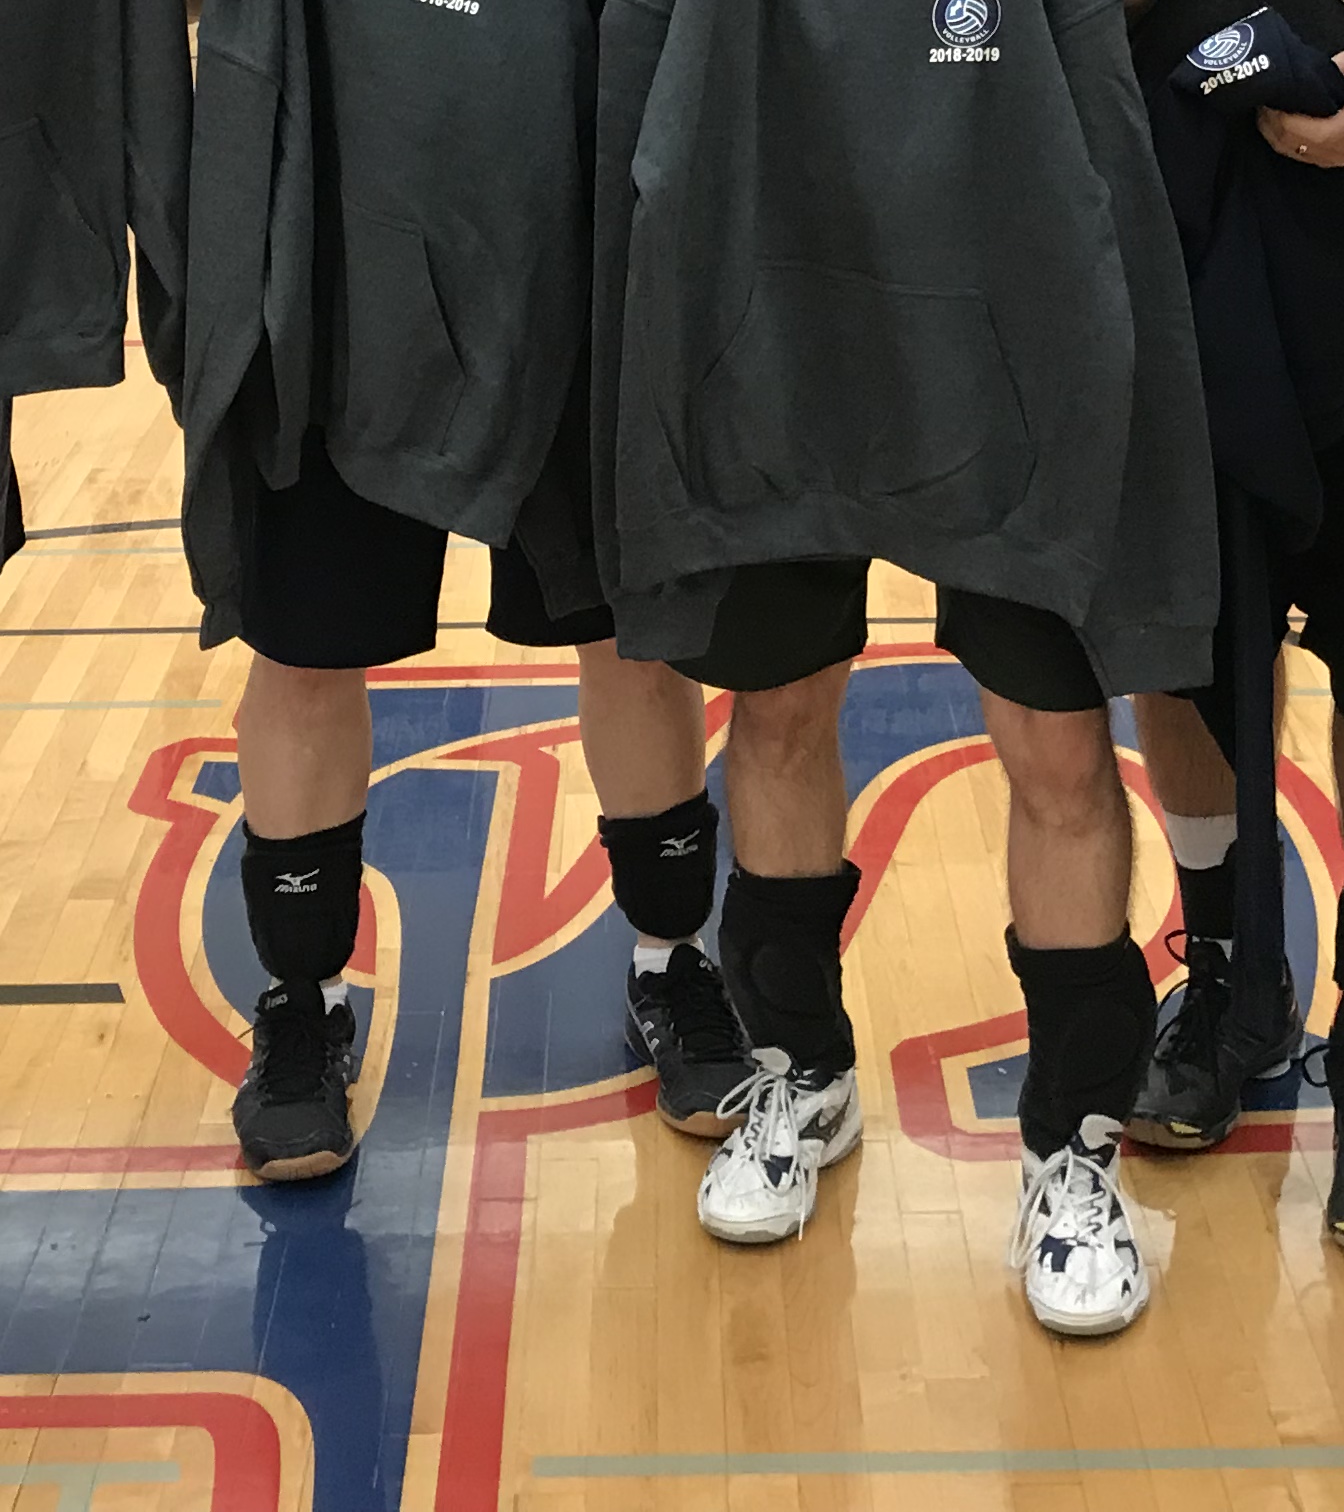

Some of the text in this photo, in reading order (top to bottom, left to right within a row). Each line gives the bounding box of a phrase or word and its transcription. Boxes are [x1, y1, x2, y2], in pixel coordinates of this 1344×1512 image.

[942, 28, 989, 43] VOLLEYBALL
[929, 47, 1000, 63] 2018-2019
[1203, 41, 1248, 65] VOLLEYBALL
[1200, 54, 1270, 95] 2018-2019
